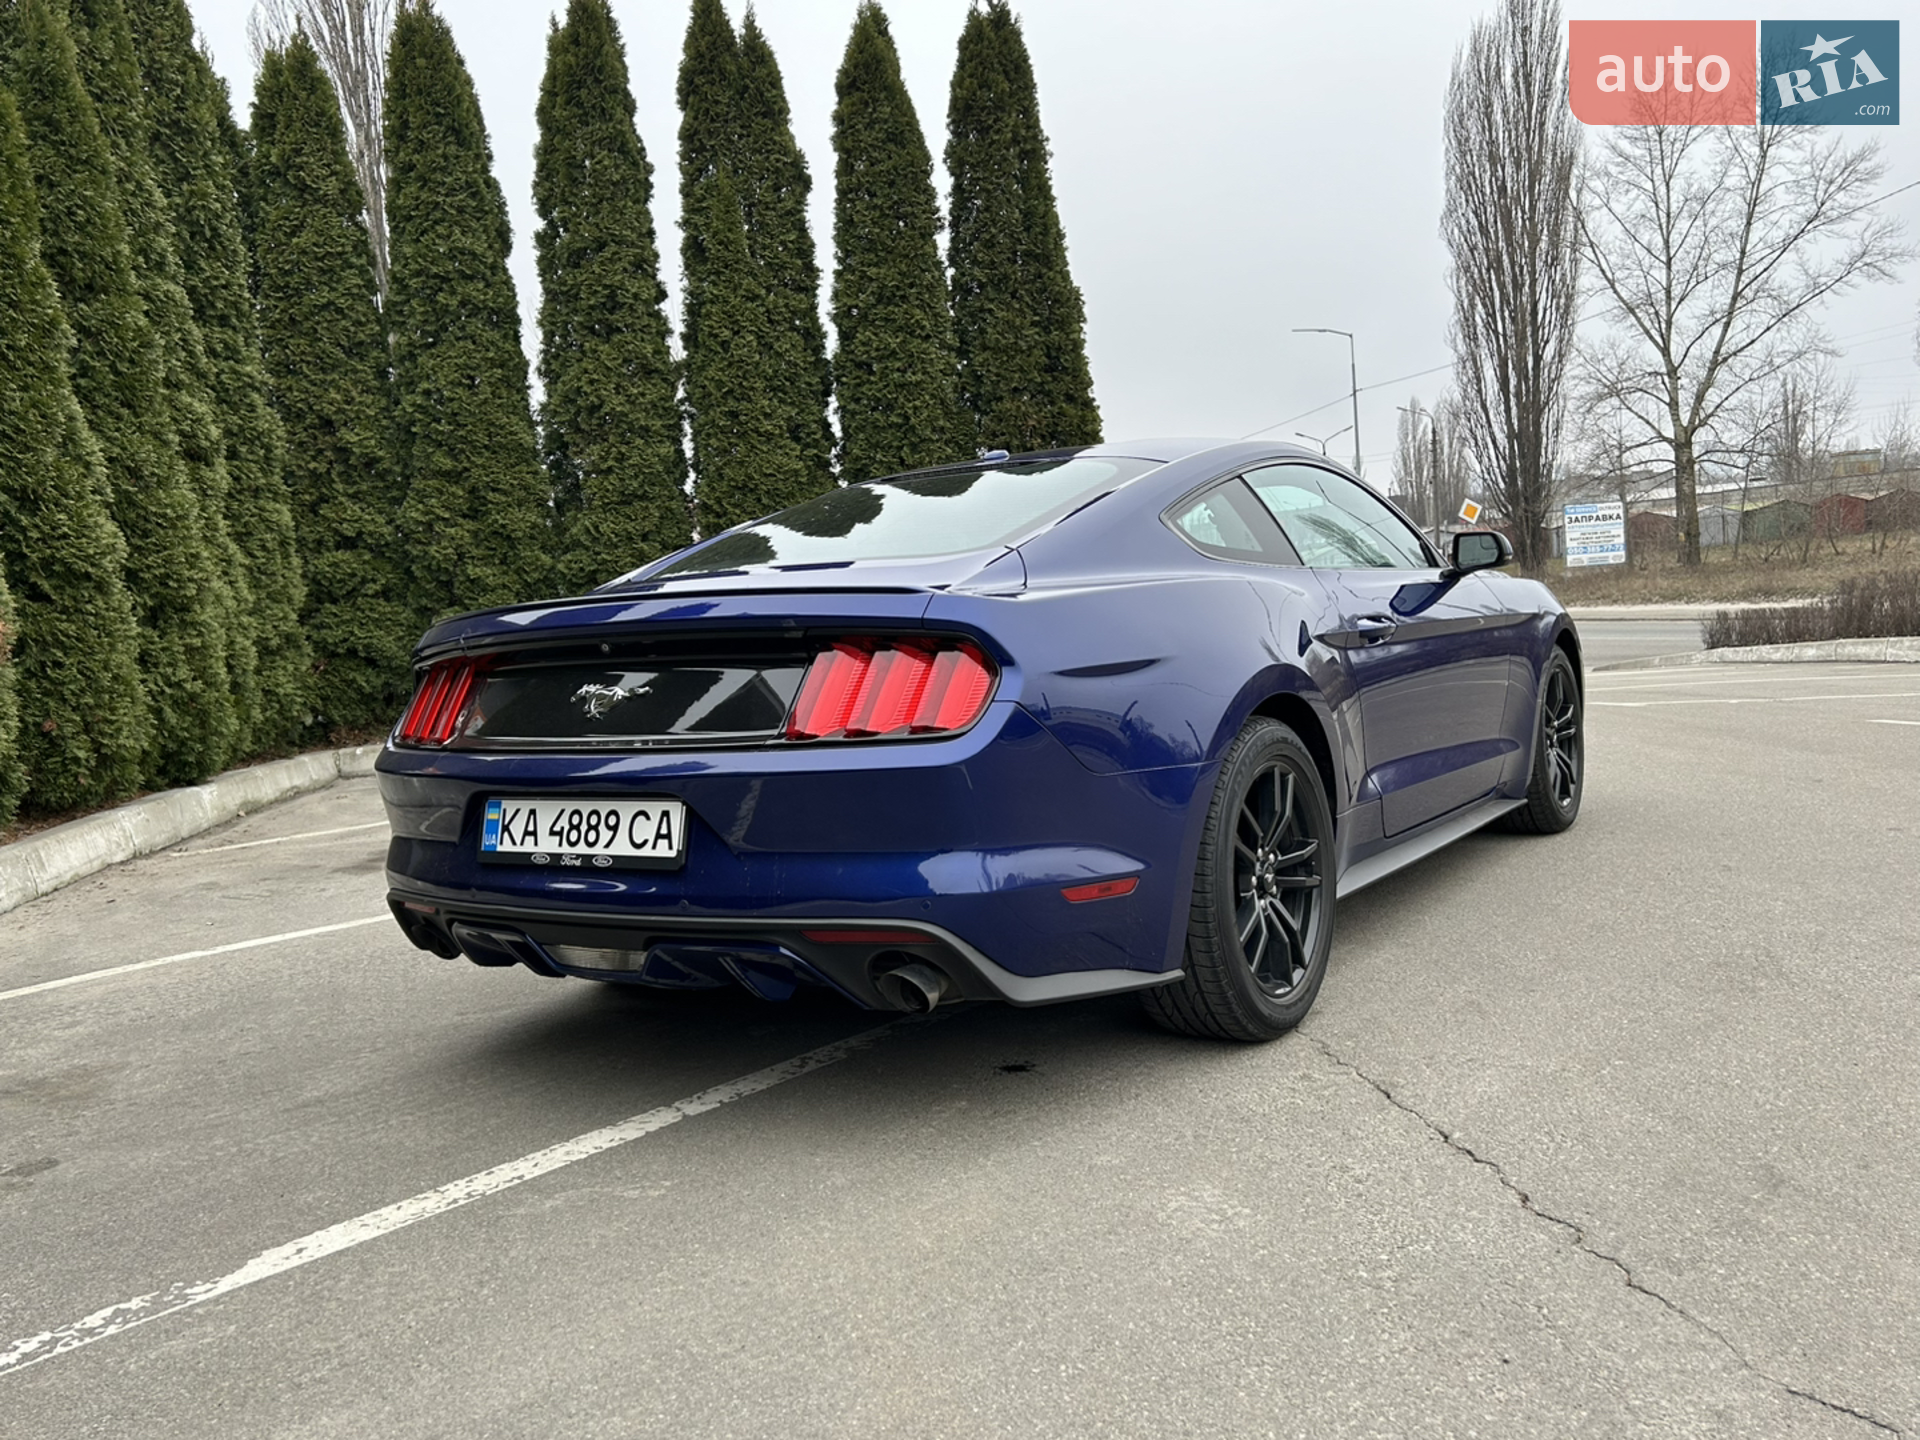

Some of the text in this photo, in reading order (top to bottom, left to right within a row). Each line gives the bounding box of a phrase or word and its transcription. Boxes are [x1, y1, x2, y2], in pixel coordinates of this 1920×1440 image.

[1567, 513, 1622, 524] ЗАПРАВКА
[499, 807, 674, 850] KA 4889 CA
[484, 833, 497, 846] UA
[560, 854, 582, 866] Ford
